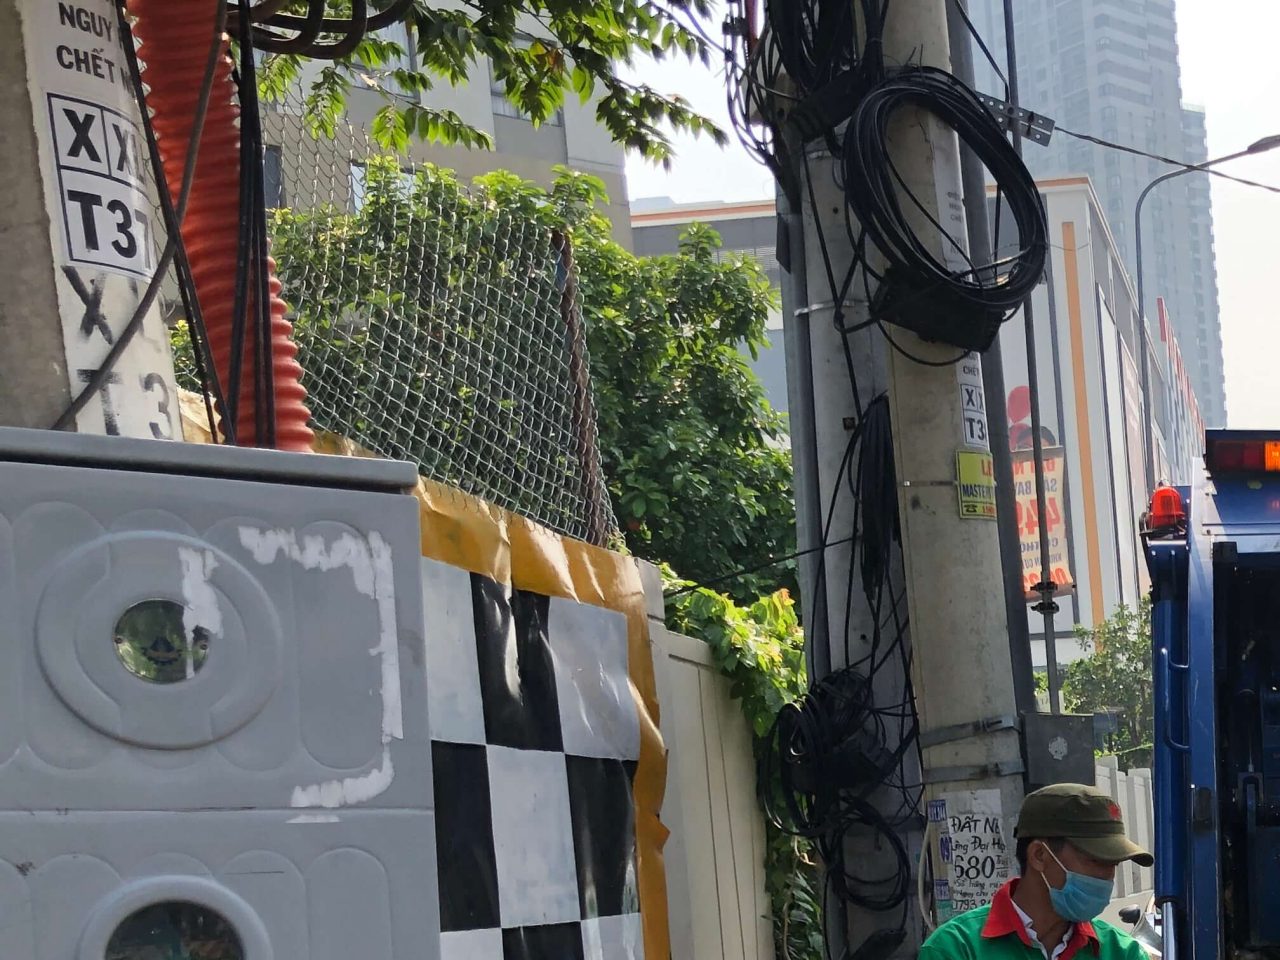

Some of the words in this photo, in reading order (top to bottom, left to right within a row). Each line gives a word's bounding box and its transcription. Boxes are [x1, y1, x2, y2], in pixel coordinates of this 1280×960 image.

[58, 2, 113, 42] NGUY
[56, 44, 115, 84] CHẾT
[62, 108, 102, 163] X
